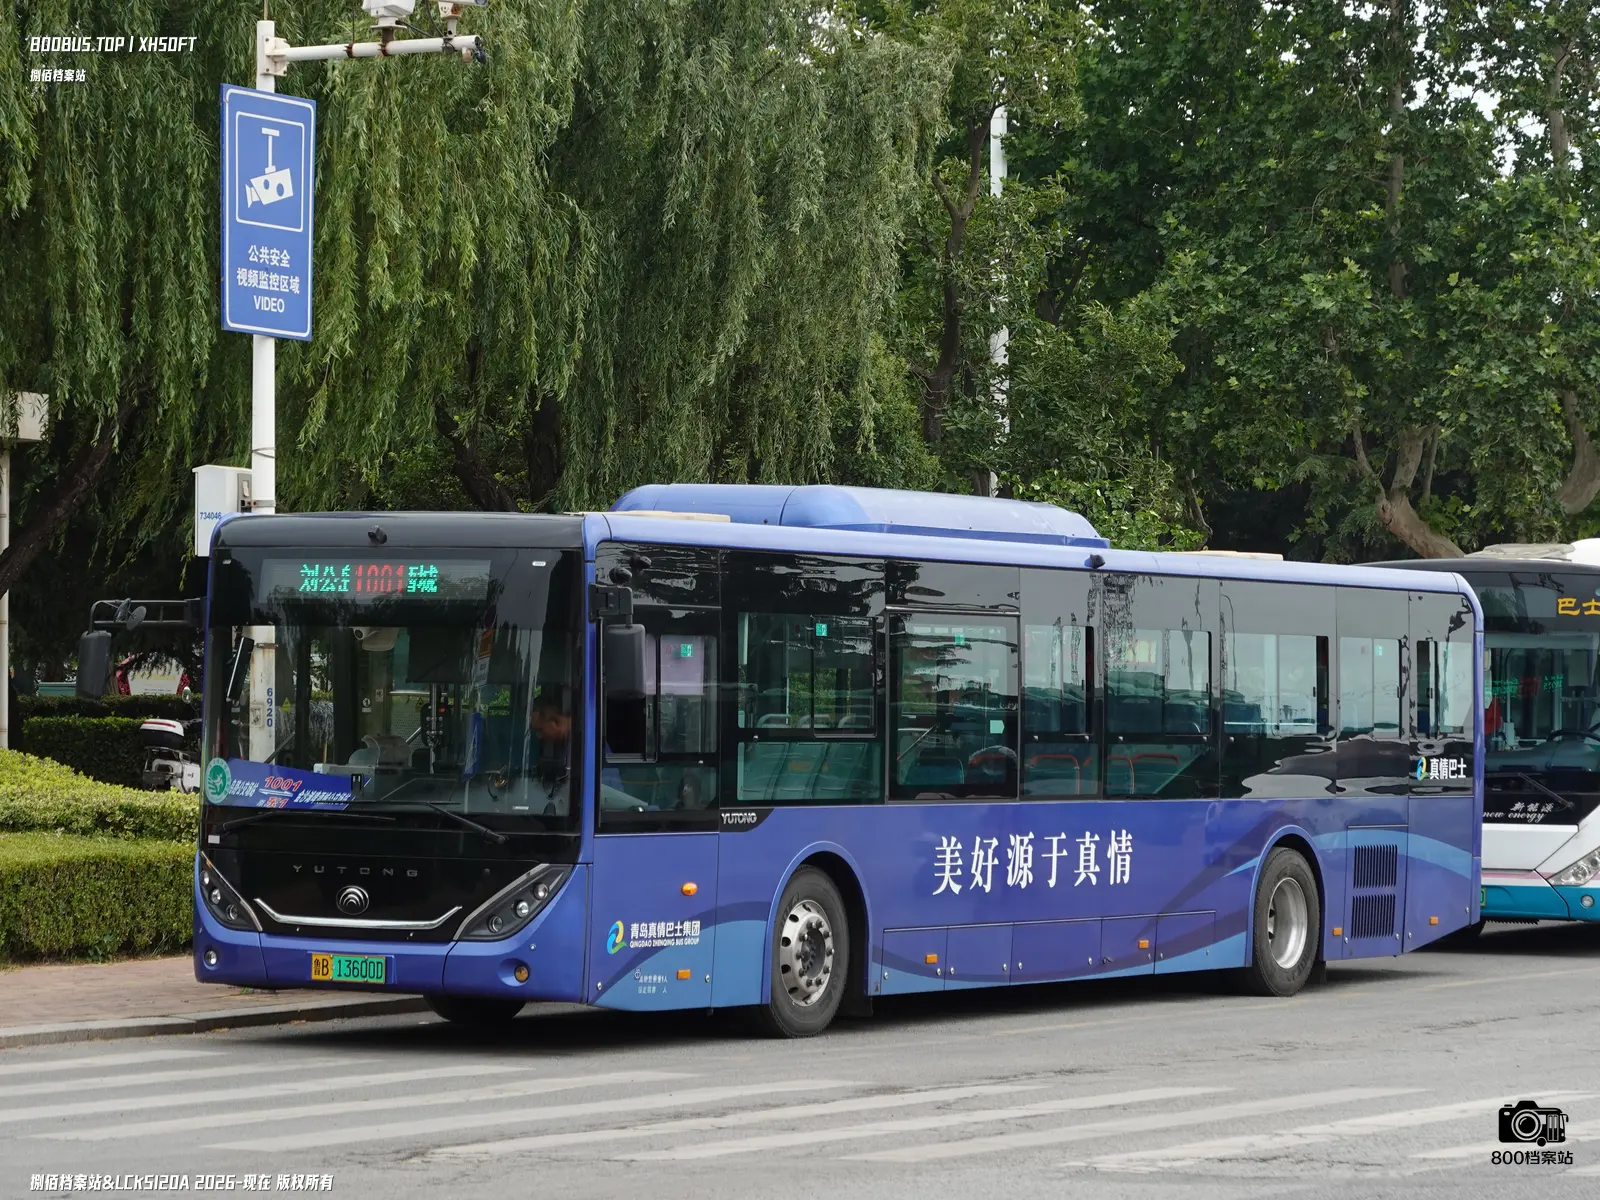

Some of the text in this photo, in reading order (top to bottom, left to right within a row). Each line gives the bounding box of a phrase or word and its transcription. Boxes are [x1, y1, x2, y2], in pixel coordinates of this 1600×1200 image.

[248, 245, 290, 268] 公共安全
[236, 267, 300, 294] 视频监控区域
[253, 295, 285, 313] VIDEO
[355, 564, 405, 593] 1001
[1557, 597, 1600, 616] 巴士
[1429, 757, 1467, 780] 真情巴士
[264, 776, 303, 792] 1001
[1510, 801, 1554, 813] 新能源
[721, 812, 758, 825] YUTONG
[1508, 812, 1546, 823] energy
[292, 864, 419, 878] YUTONG
[932, 829, 1133, 896] 美好源于真情
[630, 920, 701, 940] 青岛真情巴士集团
[629, 939, 652, 949] QINGDAO
[684, 936, 700, 945] GROUP
